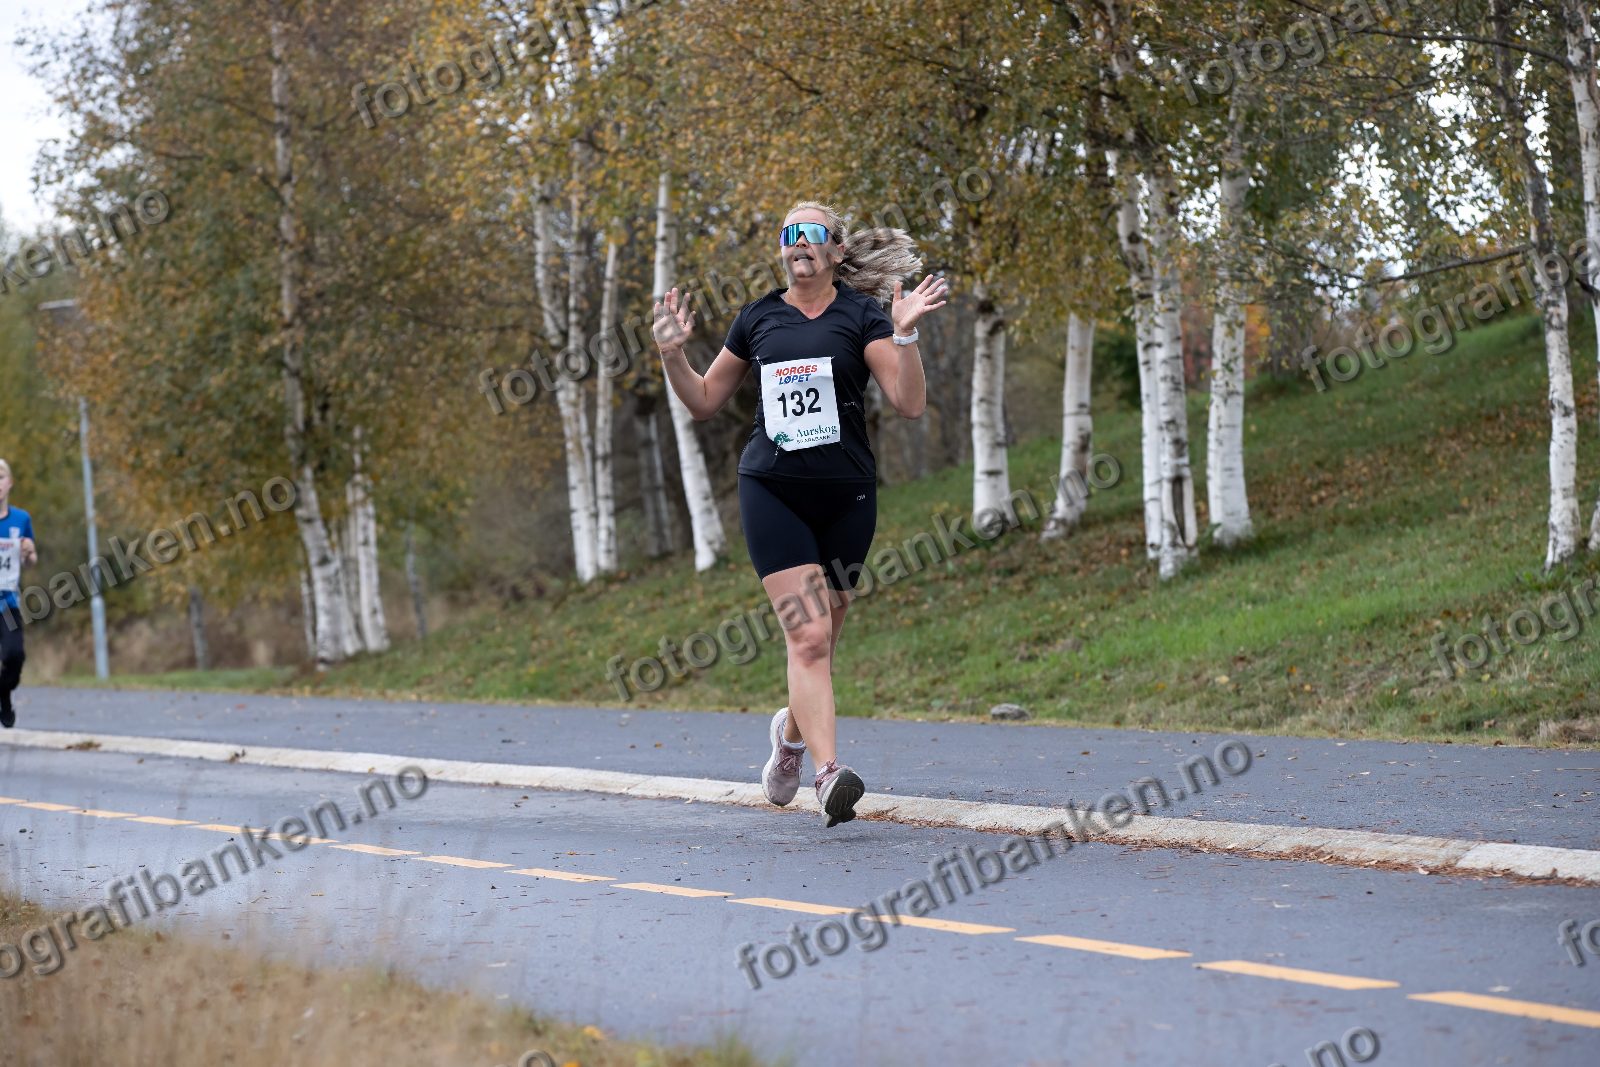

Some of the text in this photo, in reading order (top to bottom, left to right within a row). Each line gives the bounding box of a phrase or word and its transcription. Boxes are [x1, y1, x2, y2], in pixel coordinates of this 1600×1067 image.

[774, 365, 817, 377] NORGES
[779, 374, 811, 385] LØPET
[777, 387, 822, 418] 132
[796, 424, 838, 438] Aurskog
